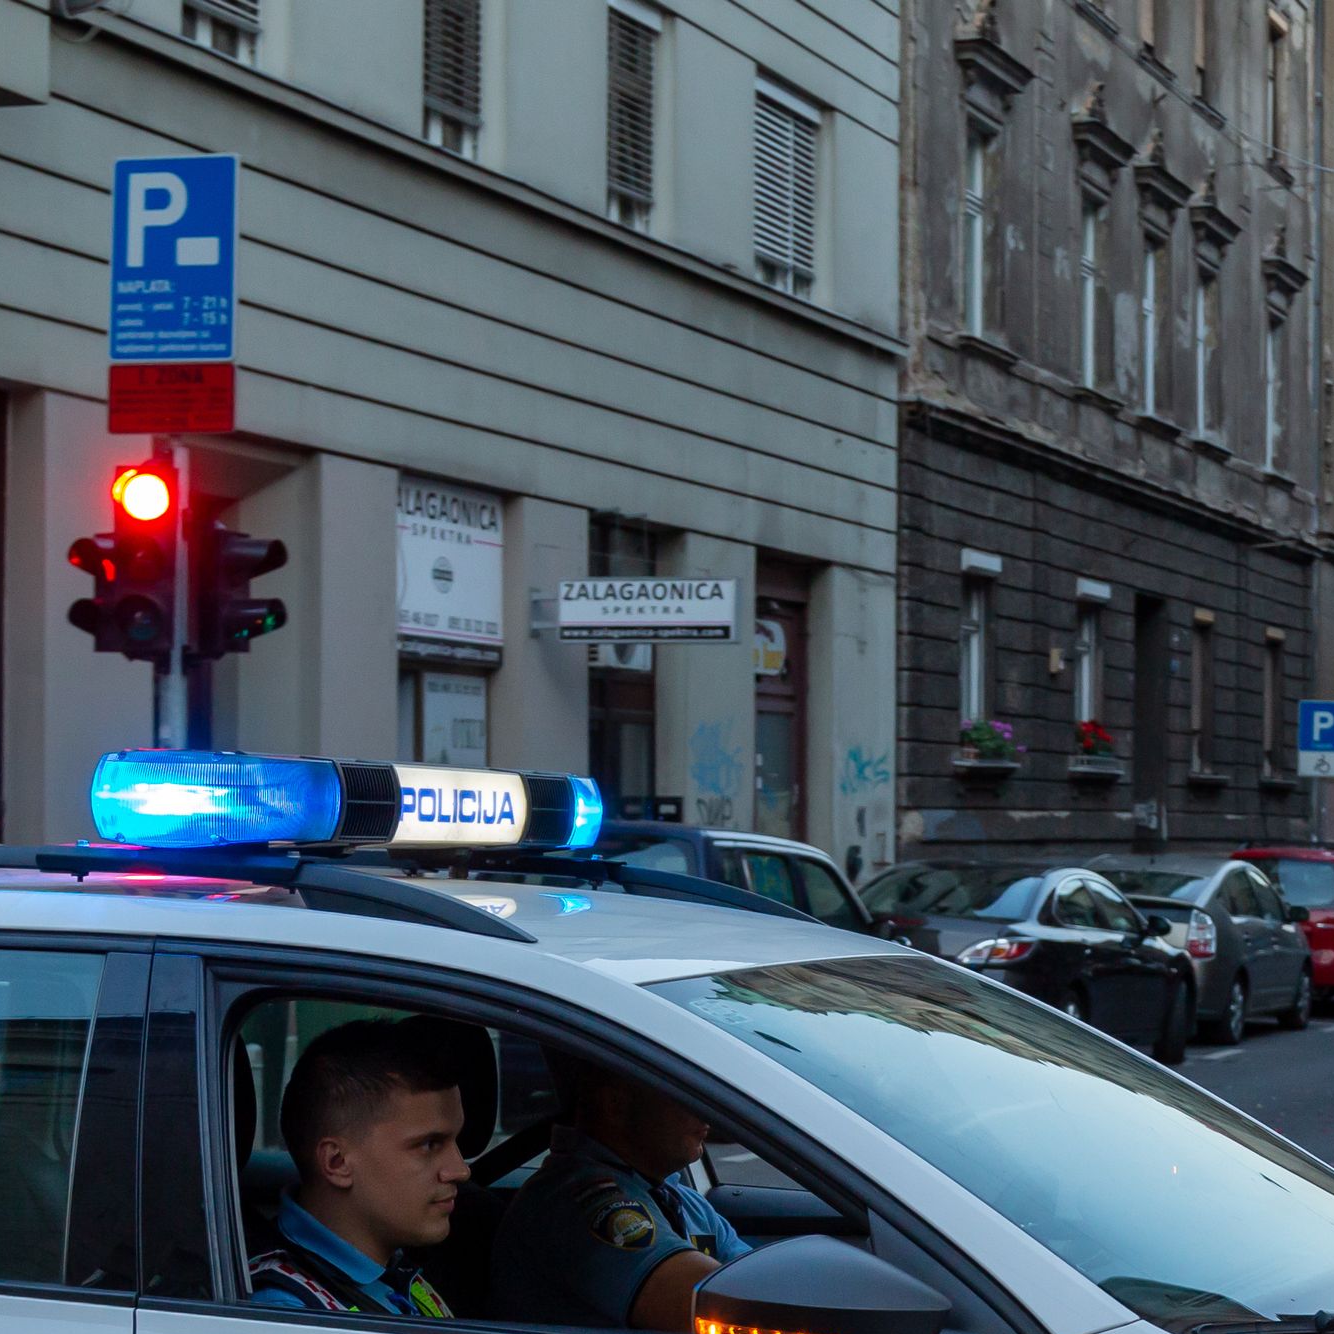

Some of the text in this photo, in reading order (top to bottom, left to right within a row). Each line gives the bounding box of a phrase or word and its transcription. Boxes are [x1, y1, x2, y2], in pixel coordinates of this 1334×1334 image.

[127, 171, 187, 267] P
[411, 523, 474, 545] SPEKTRA
[563, 582, 724, 601] ZALAGAONICA
[601, 606, 685, 615] SPEKTRA
[1313, 710, 1334, 741] P
[400, 786, 515, 825] POLICIJA
